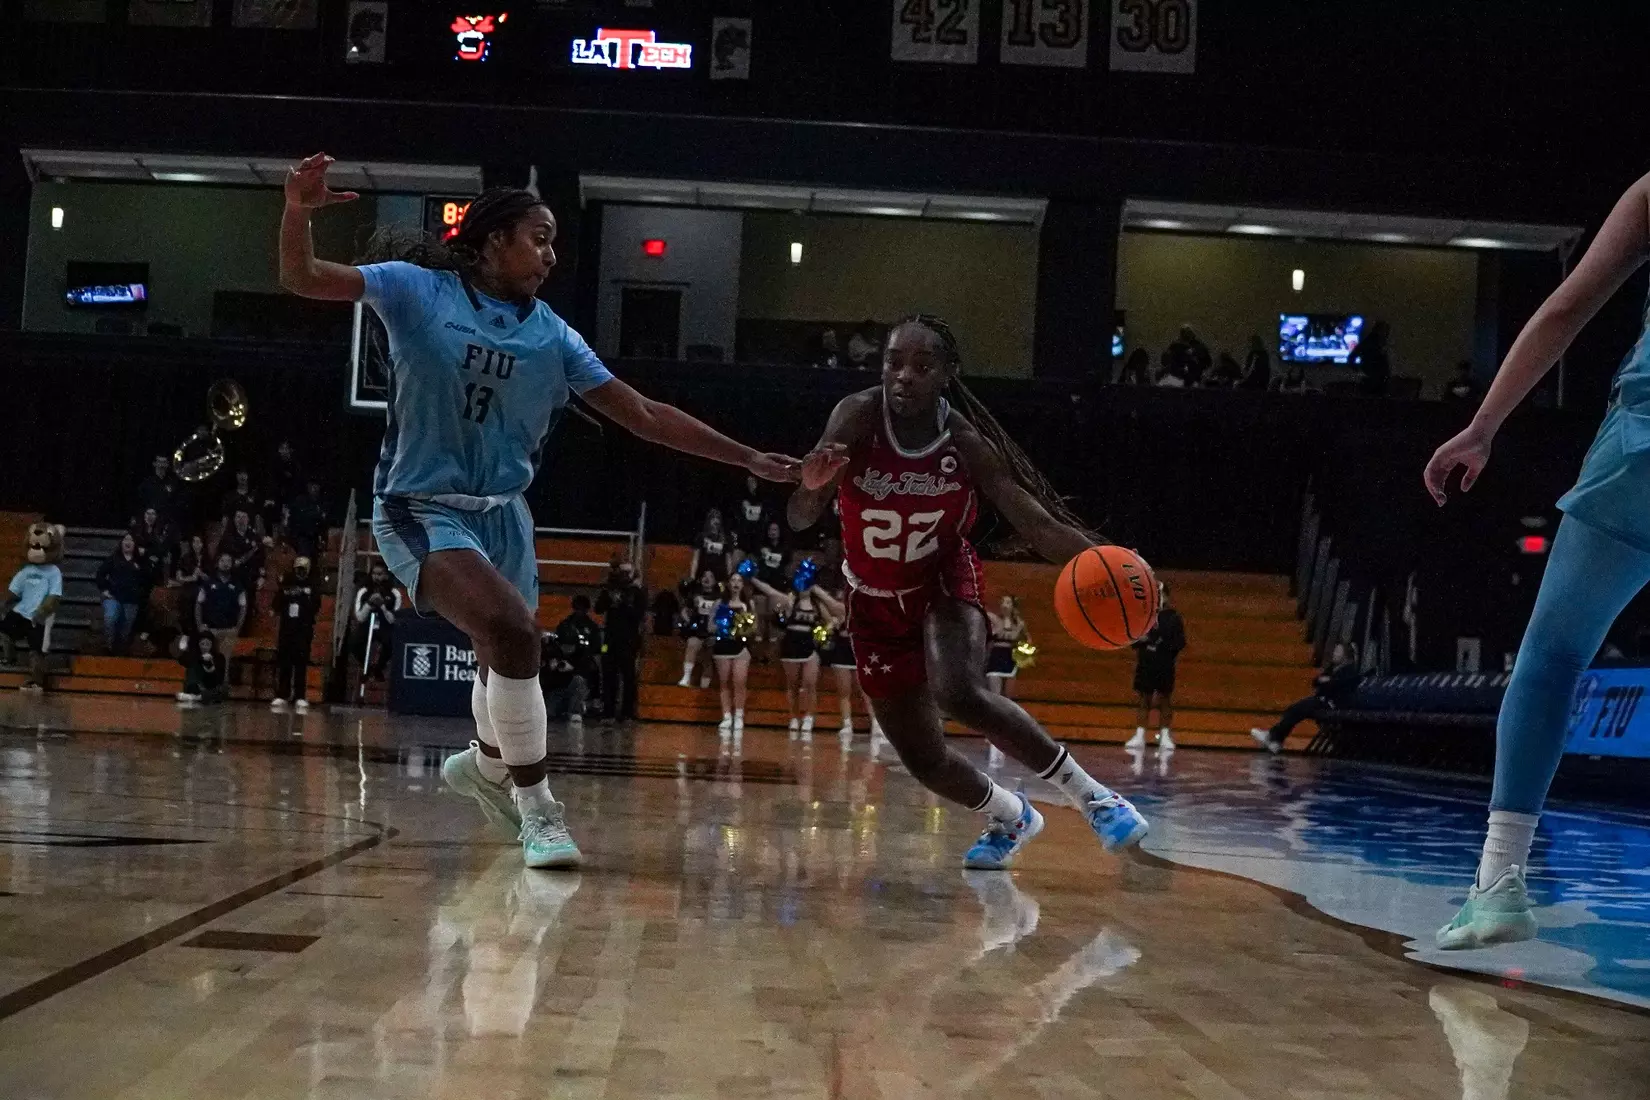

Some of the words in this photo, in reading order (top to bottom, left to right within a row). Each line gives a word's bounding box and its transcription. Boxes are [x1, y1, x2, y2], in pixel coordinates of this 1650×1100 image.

[901, 0, 967, 43] 42
[1008, 0, 1082, 48] 13
[1119, 0, 1191, 53] 30
[443, 202, 473, 225] 8:
[461, 343, 516, 380] FIU
[462, 382, 494, 424] 13
[853, 467, 894, 501] Lady
[861, 508, 946, 563] 22
[1588, 685, 1645, 738] FIU
